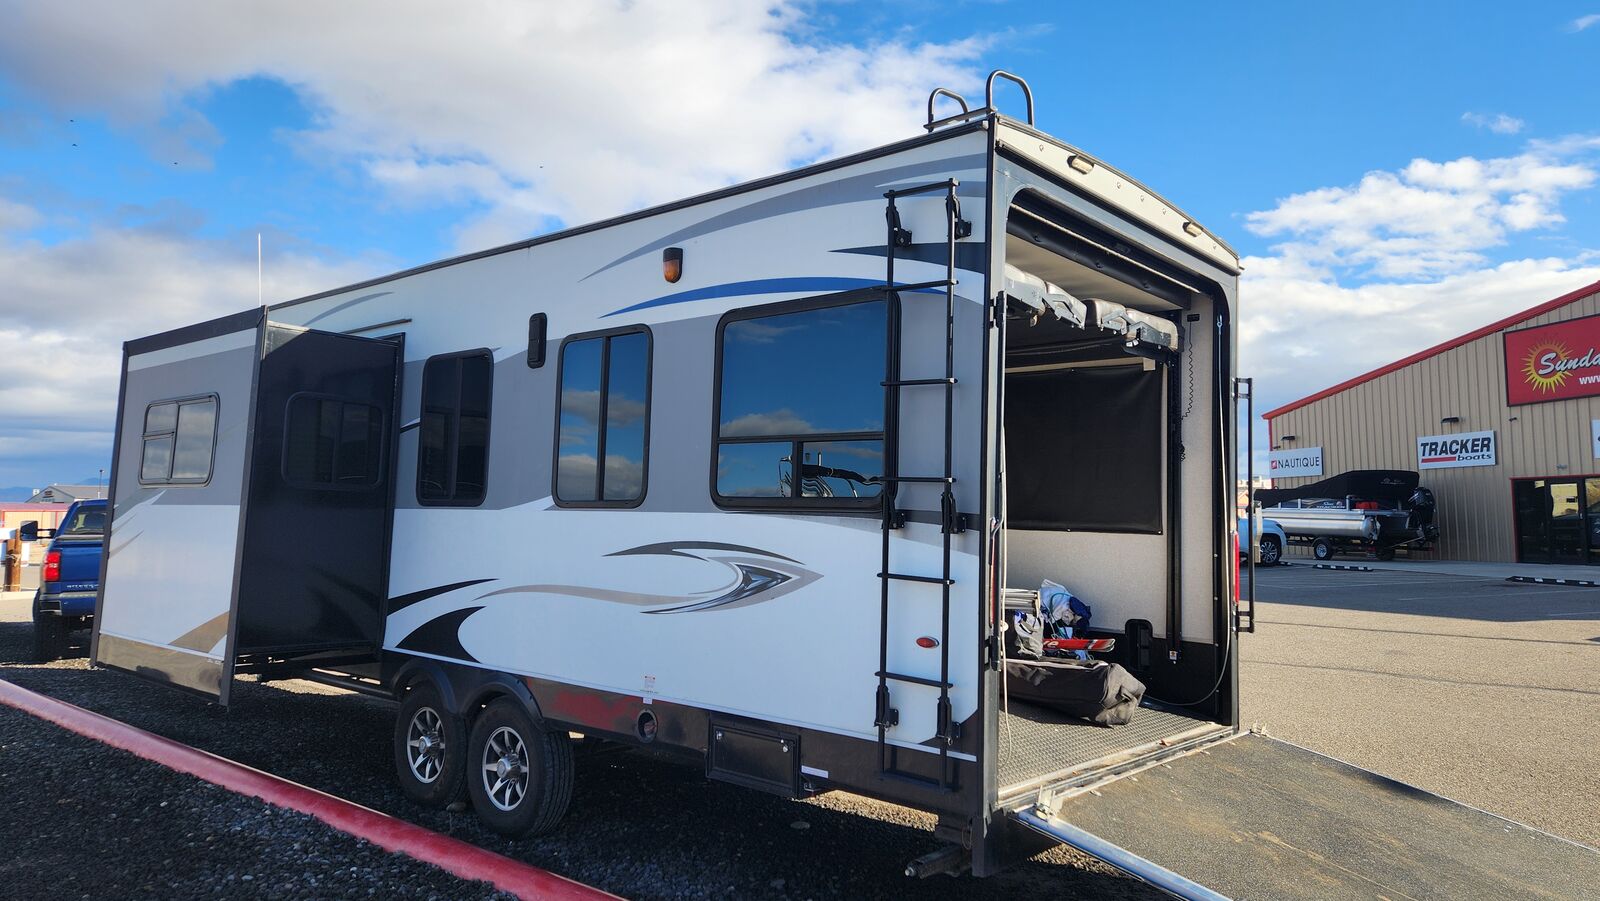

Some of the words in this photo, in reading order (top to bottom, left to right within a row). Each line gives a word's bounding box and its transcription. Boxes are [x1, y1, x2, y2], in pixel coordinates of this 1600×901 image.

[1420, 437, 1491, 456] TRACKER
[1278, 456, 1320, 469] NAUTIQUE
[1457, 453, 1492, 461] boats
